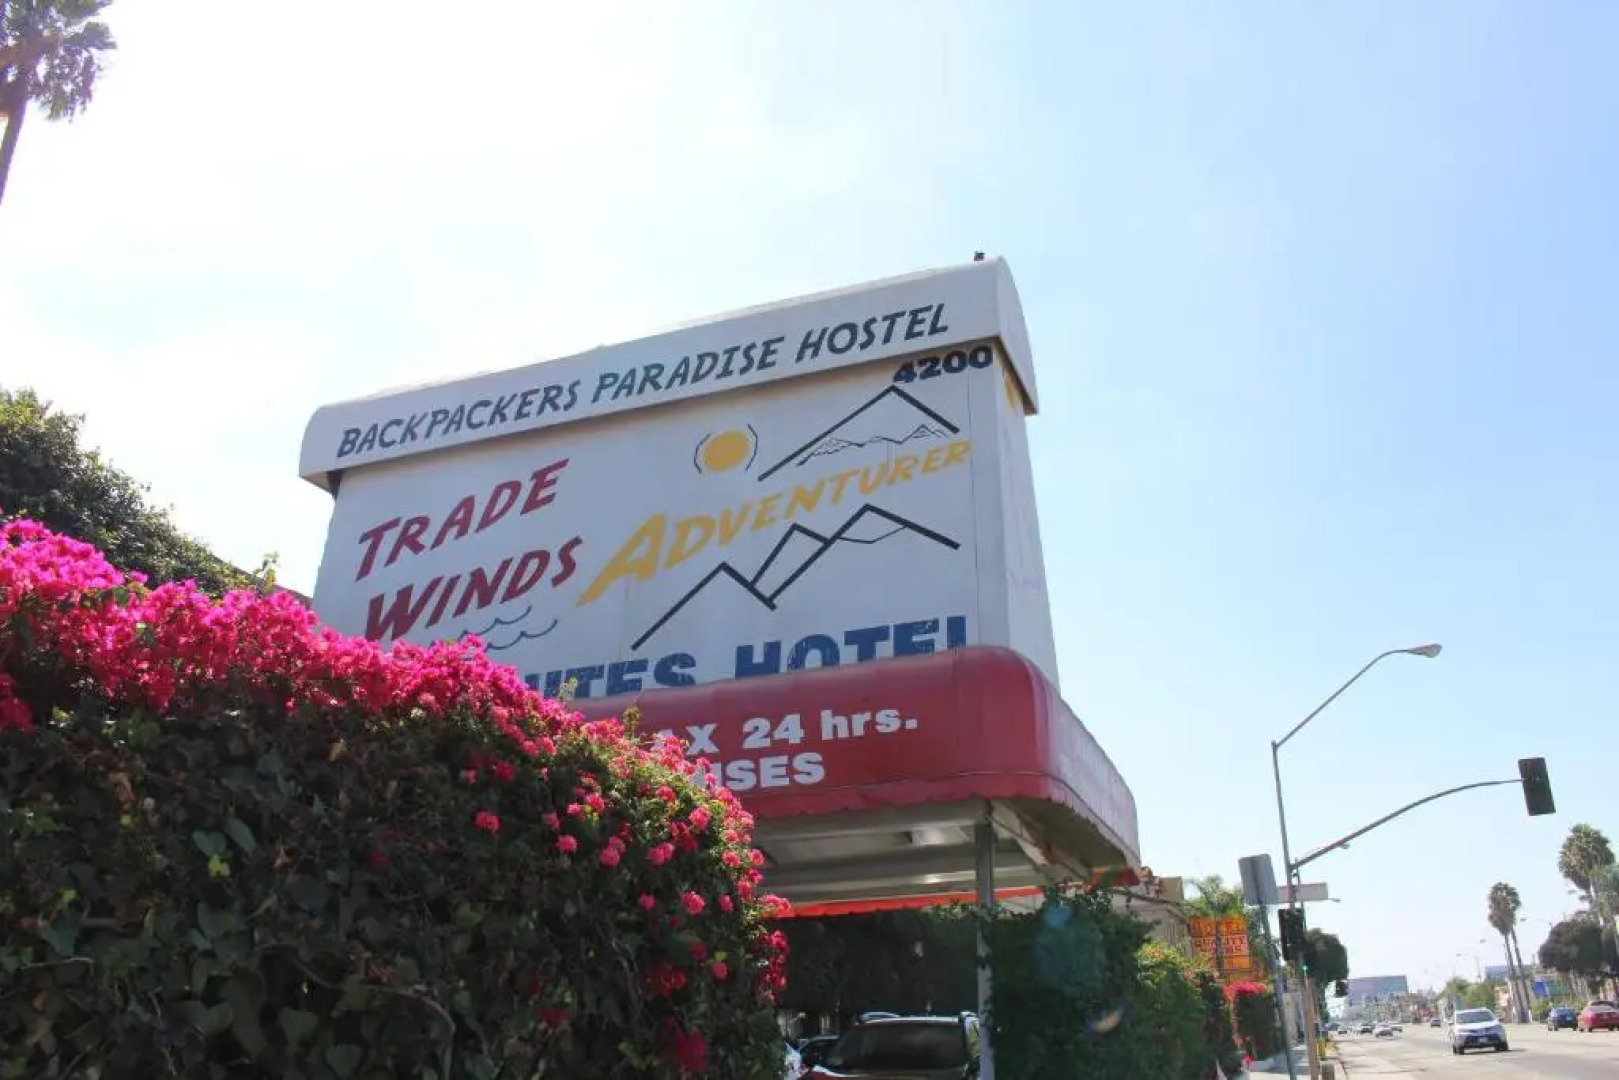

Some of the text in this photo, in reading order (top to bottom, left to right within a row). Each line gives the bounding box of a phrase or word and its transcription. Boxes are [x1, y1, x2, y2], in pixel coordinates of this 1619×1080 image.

[337, 303, 948, 458] BACKPACKERS PARADISE HOSTEL
[893, 345, 993, 384] 4200
[355, 458, 569, 582] TRADE
[575, 441, 972, 608] ADVENTURER
[364, 536, 582, 643] WINDS
[742, 713, 804, 750] 24
[821, 708, 918, 741] hrs.
